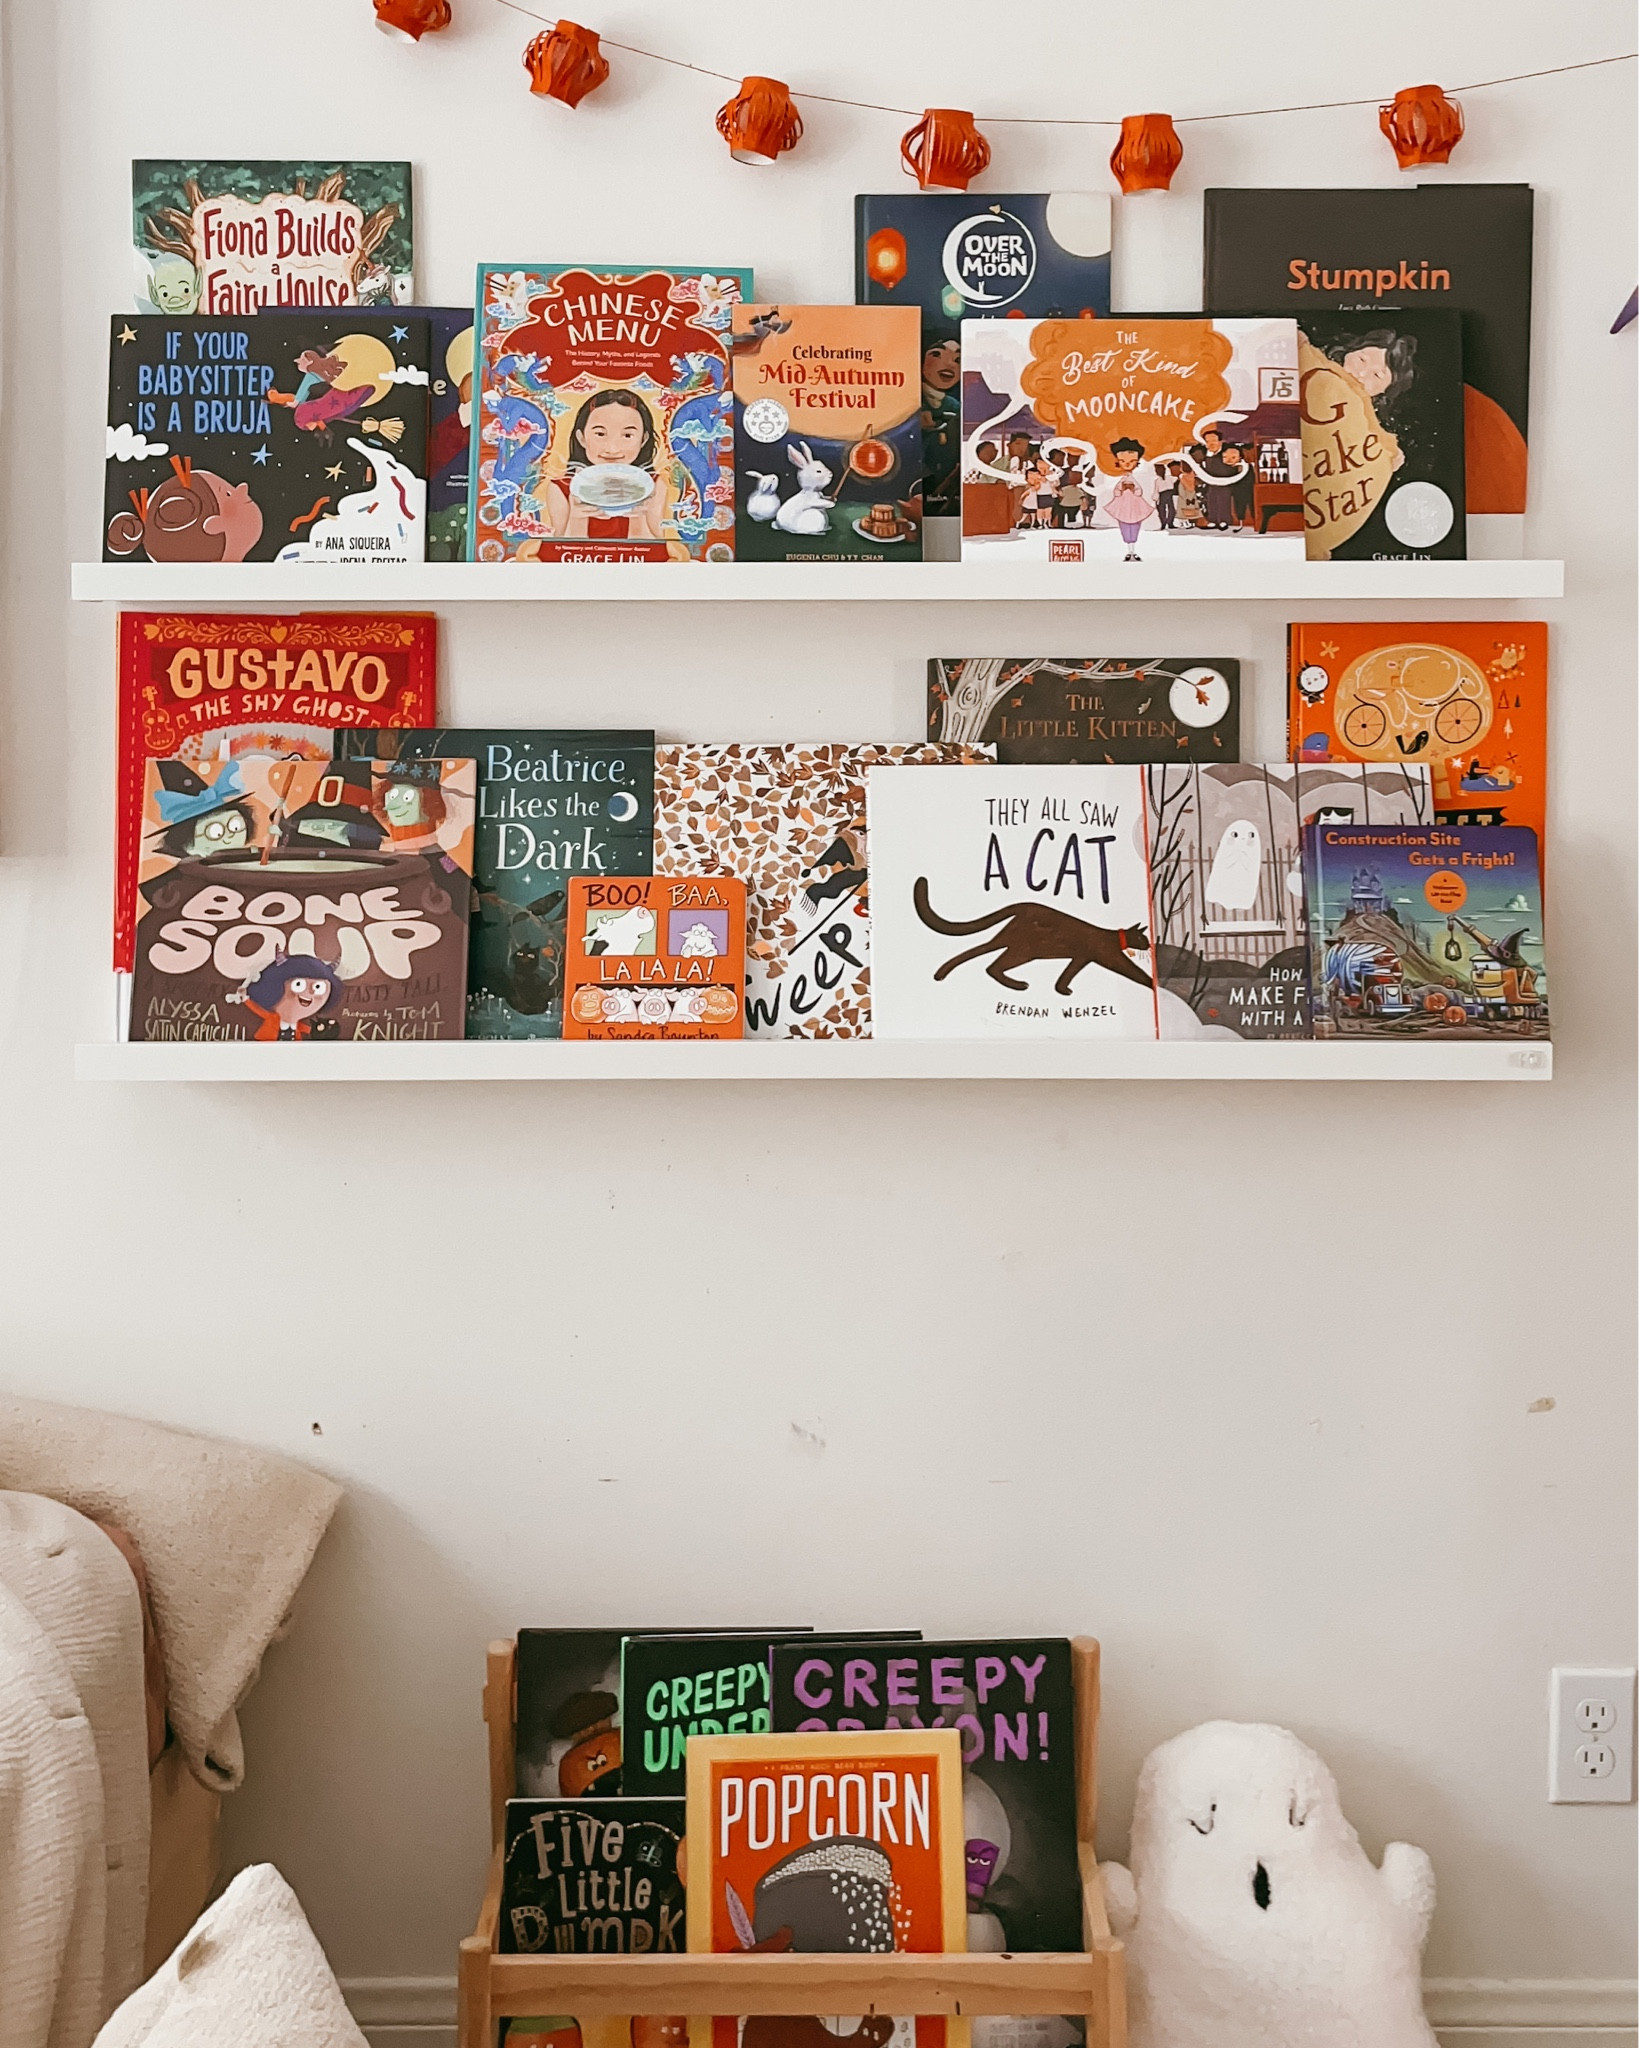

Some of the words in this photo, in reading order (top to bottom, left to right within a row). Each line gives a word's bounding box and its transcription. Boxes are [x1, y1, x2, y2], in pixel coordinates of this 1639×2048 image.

[203, 208, 268, 260] Fiona
[275, 209, 355, 259] Builds
[965, 235, 1026, 255] OVER
[271, 264, 280, 275] a
[962, 255, 1027, 277] MOON
[980, 252, 1008, 263] THE
[276, 273, 349, 307] House
[1286, 259, 1451, 297] Stumpkin
[543, 292, 684, 331] CHINESE
[166, 332, 182, 360] IF
[194, 332, 249, 360] YOUR
[568, 319, 661, 347] MENU
[1116, 330, 1138, 345] THE
[792, 345, 872, 363] Celebrating
[1062, 348, 1122, 385] Best
[1123, 349, 1199, 379] Kind
[139, 365, 274, 397] BABYSITTER
[759, 360, 905, 388] Mid-Autumn
[1122, 376, 1136, 388] OF
[1269, 372, 1294, 398] 店
[789, 387, 876, 409] Festival
[1065, 391, 1196, 424] MOONCAKE
[138, 402, 156, 432] IS
[167, 402, 182, 432] A
[195, 402, 272, 434] BRUJA
[1302, 430, 1383, 481] ake
[1304, 477, 1374, 529] Star
[325, 537, 345, 550] ANA
[349, 537, 391, 550] SIQUEIRA
[1053, 544, 1080, 555] PEARL
[1372, 552, 1408, 560] GRACE
[1412, 552, 1431, 560] LIN
[561, 551, 613, 563] GRACE
[786, 553, 820, 561] EUGENIA
[822, 553, 839, 561] CHU
[191, 695, 231, 721] THE
[242, 694, 286, 713] SHY
[293, 696, 369, 725] GHOST
[1066, 693, 1104, 712] THE
[1001, 716, 1079, 741] LITTLE
[1087, 716, 1178, 741] KITTEN
[484, 745, 625, 783] Beatrice
[479, 786, 558, 818] Likes
[565, 792, 600, 816] the
[985, 798, 1030, 826] THEY
[1041, 796, 1070, 821] ALL
[1080, 800, 1119, 828] SAW
[495, 823, 607, 870] Dark
[1325, 832, 1427, 846] Construction
[1430, 832, 1461, 846] Site
[984, 832, 1010, 891] A
[1026, 828, 1116, 904] CAT
[1408, 852, 1446, 866] Gets
[1448, 856, 1458, 866] a
[1462, 852, 1516, 870] Fright!
[181, 885, 424, 926] BONE
[582, 881, 651, 906] BOO!
[668, 884, 729, 906] BAA,
[149, 920, 442, 980] SOUP
[600, 959, 632, 982] LA
[640, 960, 667, 981] LA
[673, 958, 715, 982] LA!
[1270, 967, 1303, 982] HOW
[1229, 986, 1284, 1005] MAKE
[148, 996, 219, 1023] ALYSSA
[395, 1000, 440, 1020] TOM
[995, 1002, 1049, 1018] BRENDAN
[1062, 1005, 1116, 1019] WENZEL
[1241, 1010, 1285, 1026] WITH
[1293, 1009, 1303, 1026] A
[145, 1018, 180, 1040] SATIN
[353, 1019, 445, 1040] KNIGHT
[607, 1027, 655, 1040] Sandra
[646, 1661, 770, 1721] CREEPY
[794, 1654, 1047, 1708] CREEPY
[720, 1772, 930, 1858] POPCORN
[530, 1811, 625, 1879] Five
[558, 1866, 652, 1918] Little
